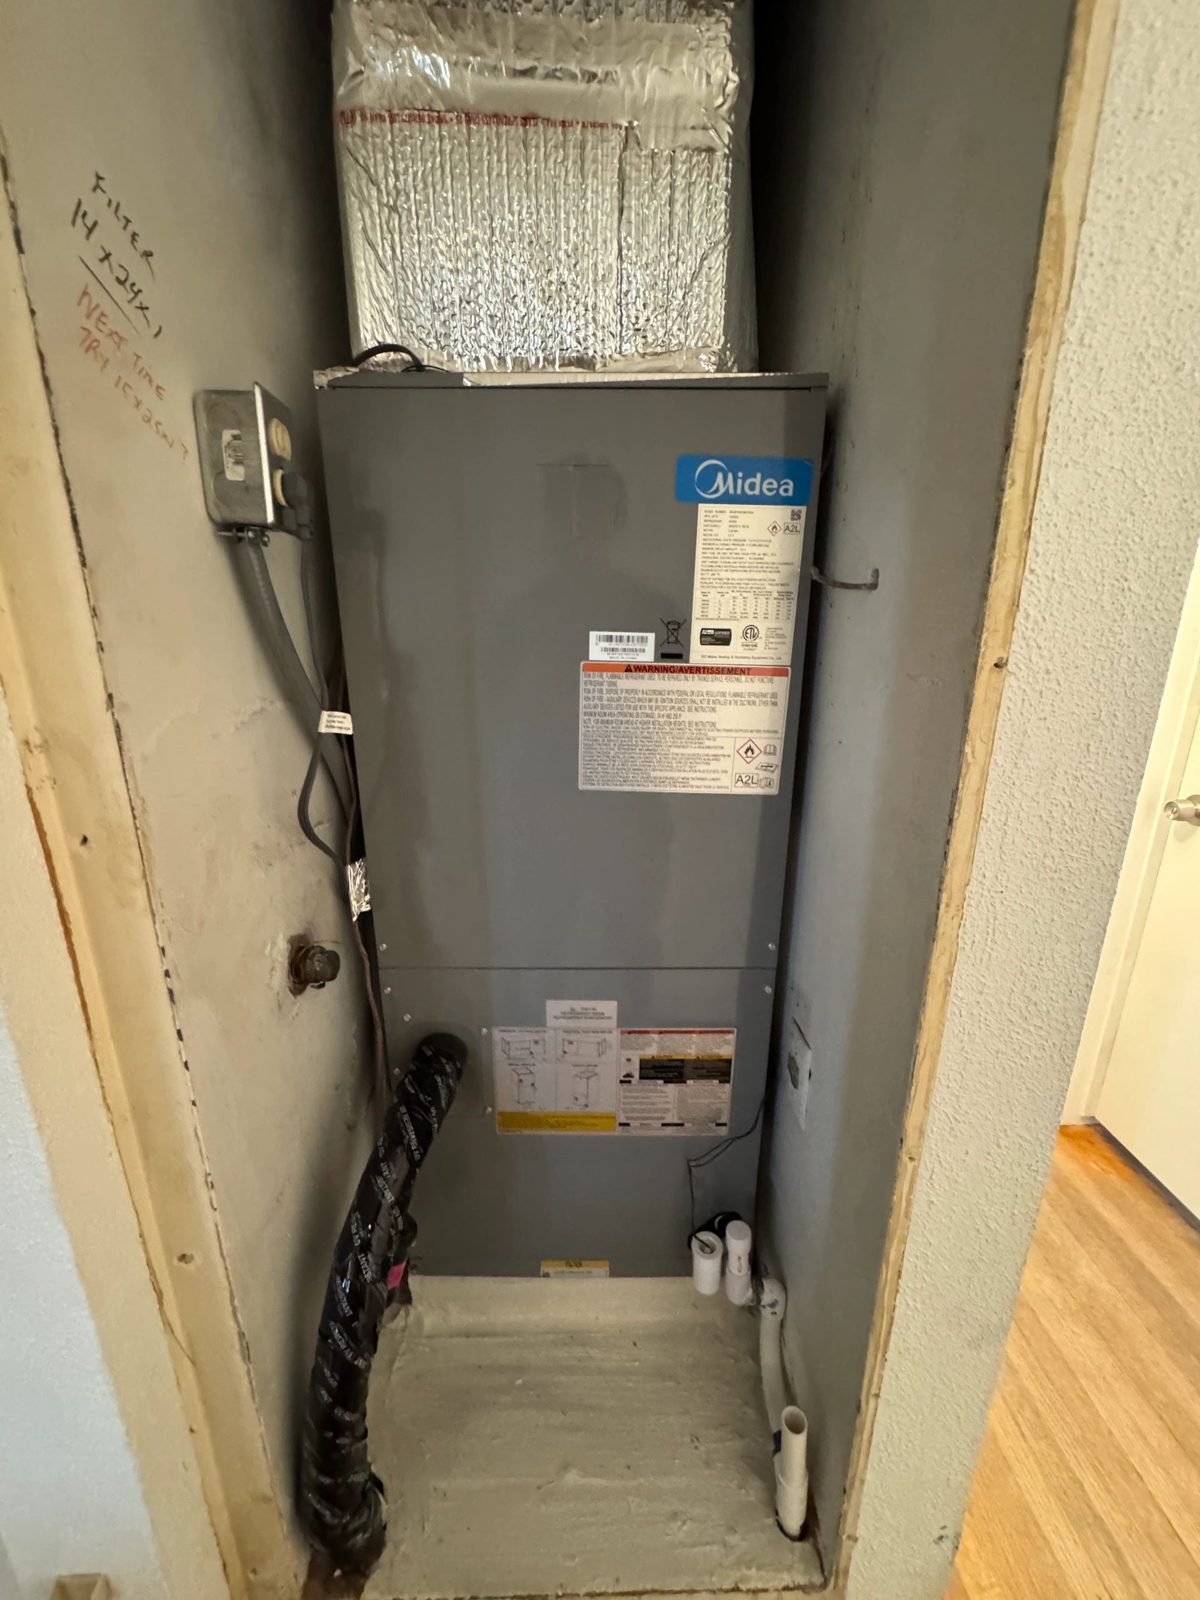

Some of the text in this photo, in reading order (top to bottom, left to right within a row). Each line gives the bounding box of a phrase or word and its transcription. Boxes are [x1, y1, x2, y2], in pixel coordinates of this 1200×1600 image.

[92, 171, 155, 281] FILTER
[77, 283, 128, 351] NEXT
[80, 326, 109, 371] TRY
[695, 460, 794, 498] Midea
[784, 524, 801, 534] A2L
[633, 664, 753, 676] WARNING/AVERTISSEMENT
[735, 774, 759, 785] A2L
